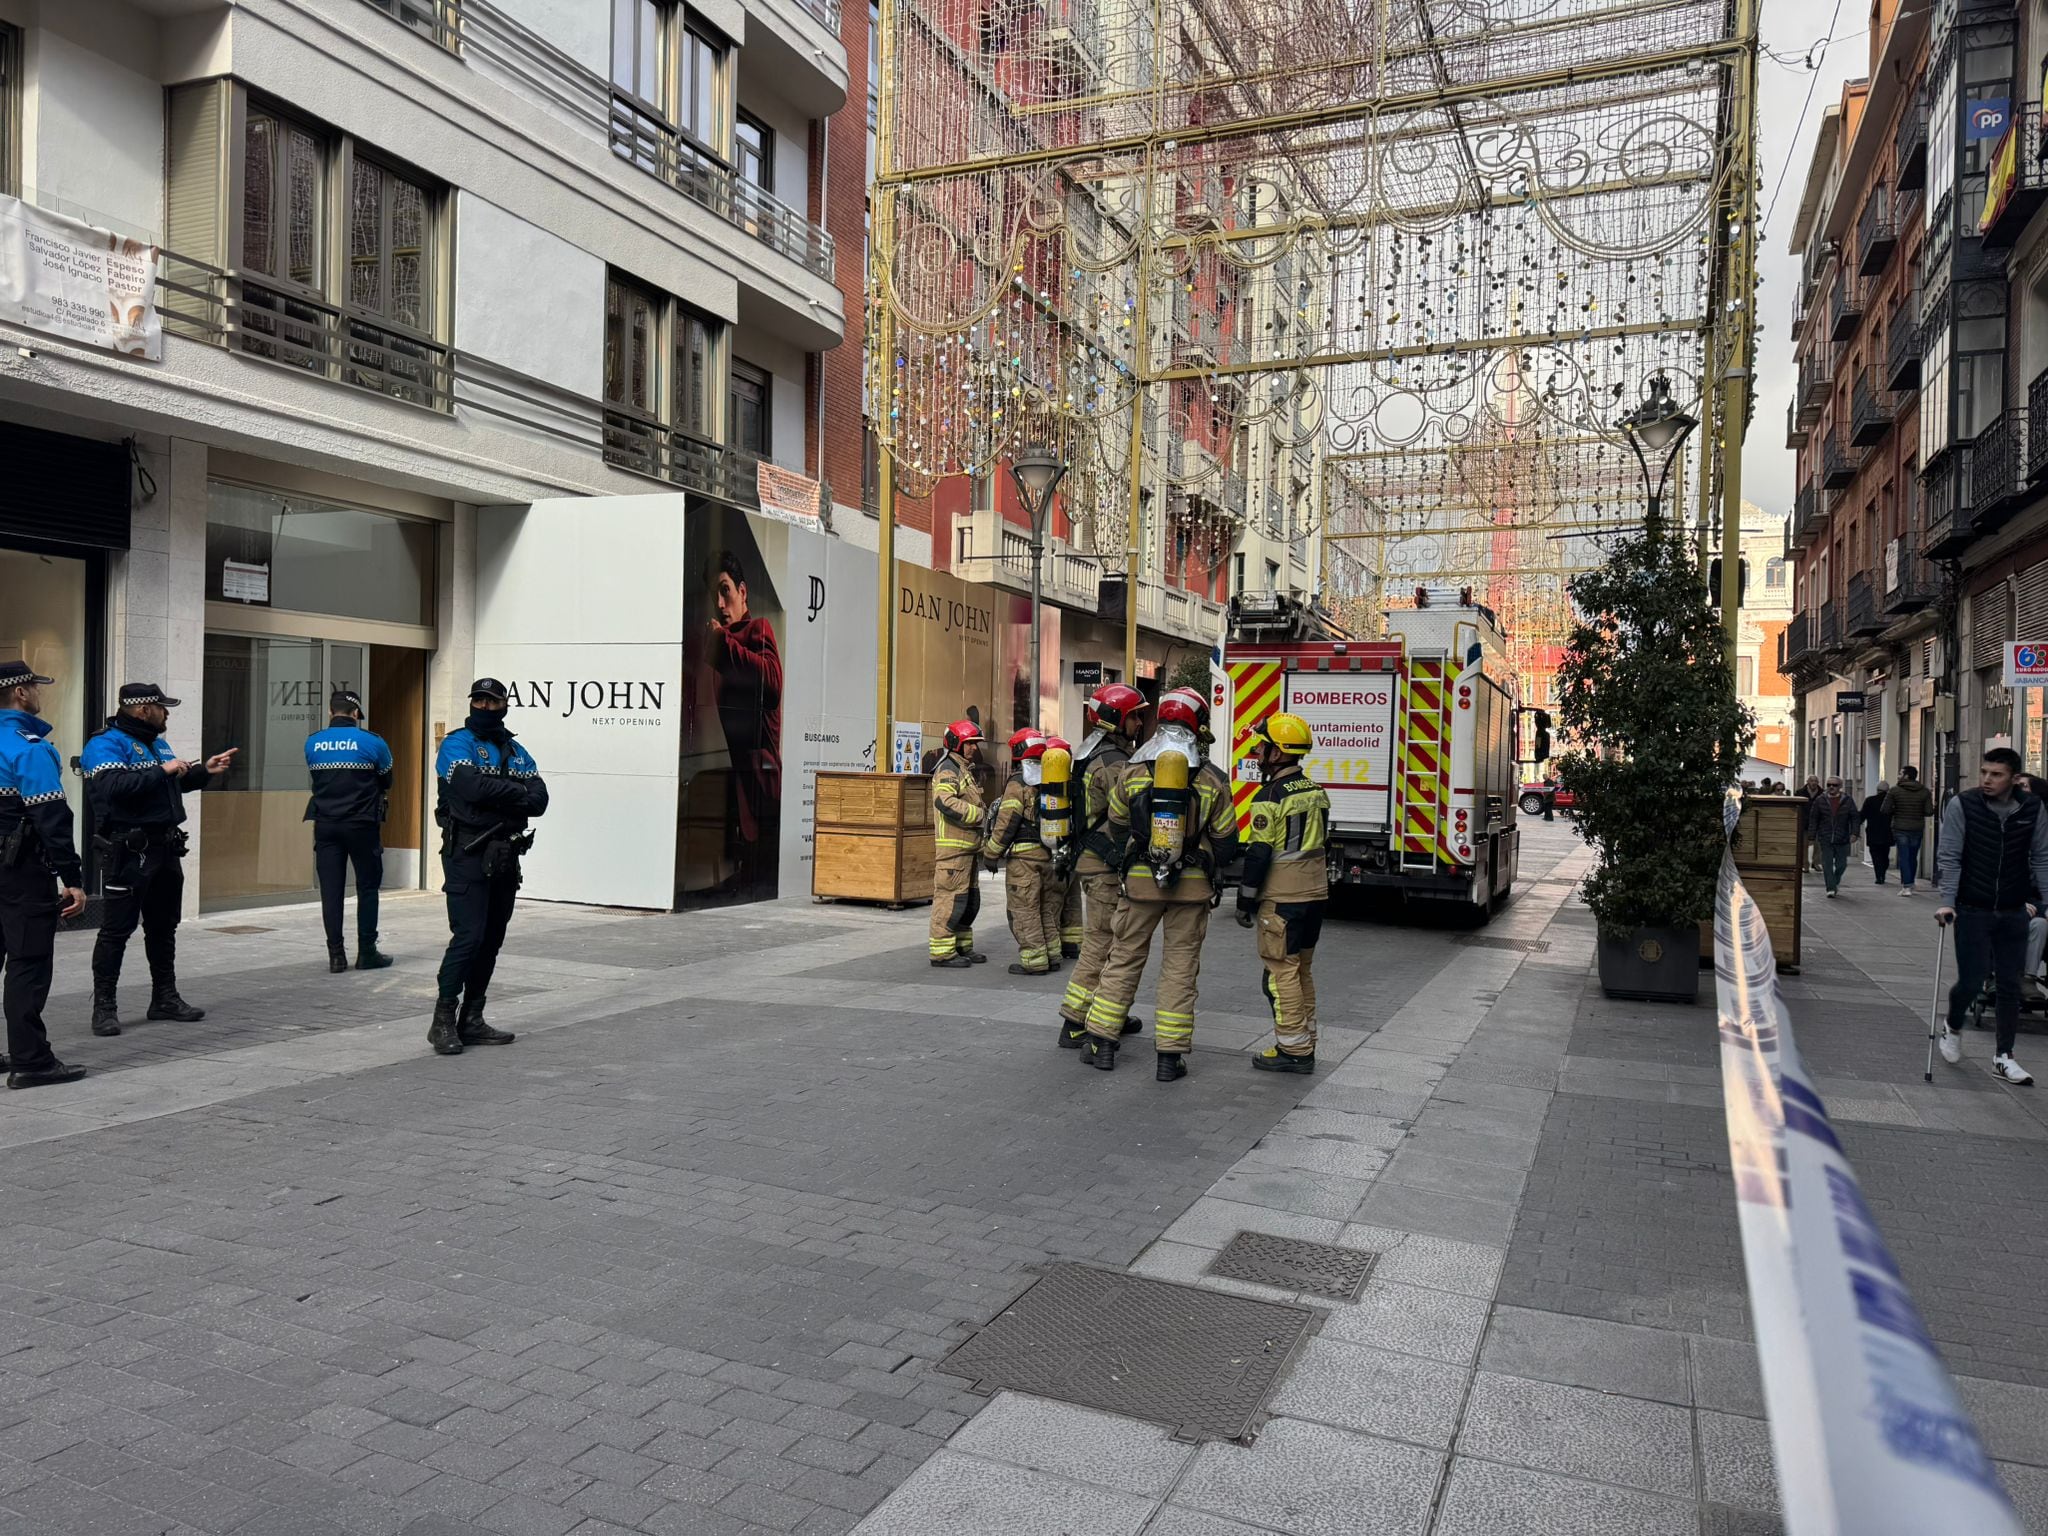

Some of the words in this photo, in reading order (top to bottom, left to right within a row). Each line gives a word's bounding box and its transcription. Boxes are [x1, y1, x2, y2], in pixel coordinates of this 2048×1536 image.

[25, 229, 70, 253] Francisco
[72, 247, 101, 263] Javier
[106, 258, 145, 274] Espeso
[29, 242, 70, 263] Salvador
[72, 256, 101, 273] López
[107, 268, 146, 284] Fabeiro
[43, 259, 65, 272] José
[68, 265, 102, 283] Ignacio
[107, 278, 142, 293] Pastor
[51, 296, 69, 308] 983
[70, 301, 87, 313] 335
[89, 306, 105, 319] 990
[56, 307, 64, 316] C/
[66, 310, 99, 326] Regalado
[900, 587, 942, 622] DAN
[944, 600, 991, 634] JOHN
[507, 681, 554, 708] AN
[562, 681, 665, 718] JOHN
[1293, 692, 1388, 705] BOMBEROS
[592, 717, 615, 725] NEXT
[619, 718, 662, 726] OPENING
[1308, 722, 1384, 733] untamiento
[313, 738, 359, 752] POLICÍA
[804, 732, 840, 743] BUSCAMOS
[1317, 736, 1380, 748] Valladolid
[1322, 757, 1370, 783] 112
[1154, 819, 1178, 827] VA-114
